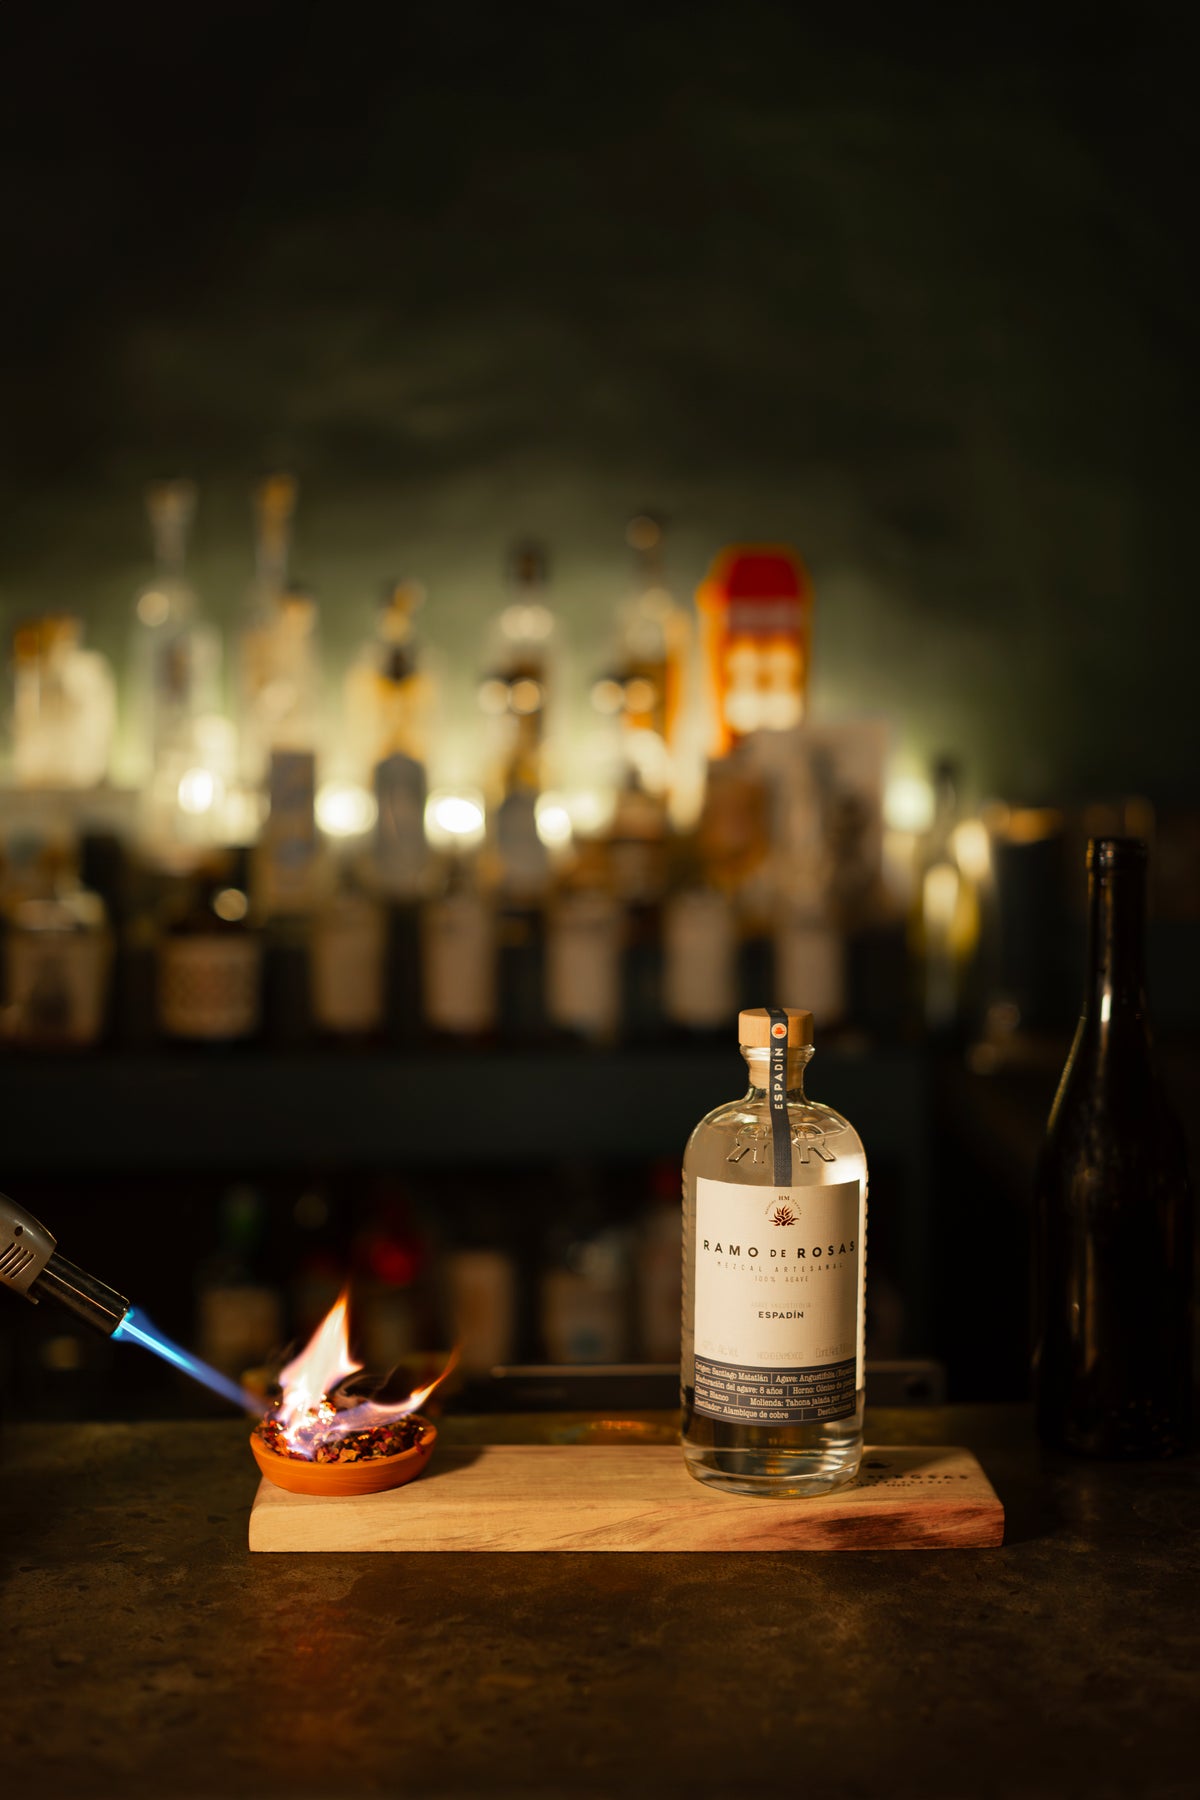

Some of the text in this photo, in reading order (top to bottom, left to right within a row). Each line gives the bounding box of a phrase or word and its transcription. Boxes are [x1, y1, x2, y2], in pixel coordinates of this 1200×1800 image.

[772, 1047, 784, 1110] ESPADÍN
[703, 1239, 855, 1259] RAMO DE ROSAS
[717, 1261, 844, 1273] MEZCAL ARTESANAL
[755, 1275, 809, 1283] 100% AGAVE
[758, 1311, 804, 1319] ESPADÍN
[711, 1367, 737, 1380] Santiago
[738, 1372, 769, 1383] Matatlán
[775, 1375, 799, 1384] Agave:
[725, 1383, 736, 1392] del
[736, 1385, 758, 1394] agave:
[759, 1386, 765, 1394] 8
[765, 1386, 784, 1395] años
[793, 1387, 815, 1395] Horno:
[785, 1399, 811, 1407] Tahona
[722, 1406, 758, 1418] Alambique
[759, 1410, 768, 1418] de
[769, 1410, 789, 1419] cobre
